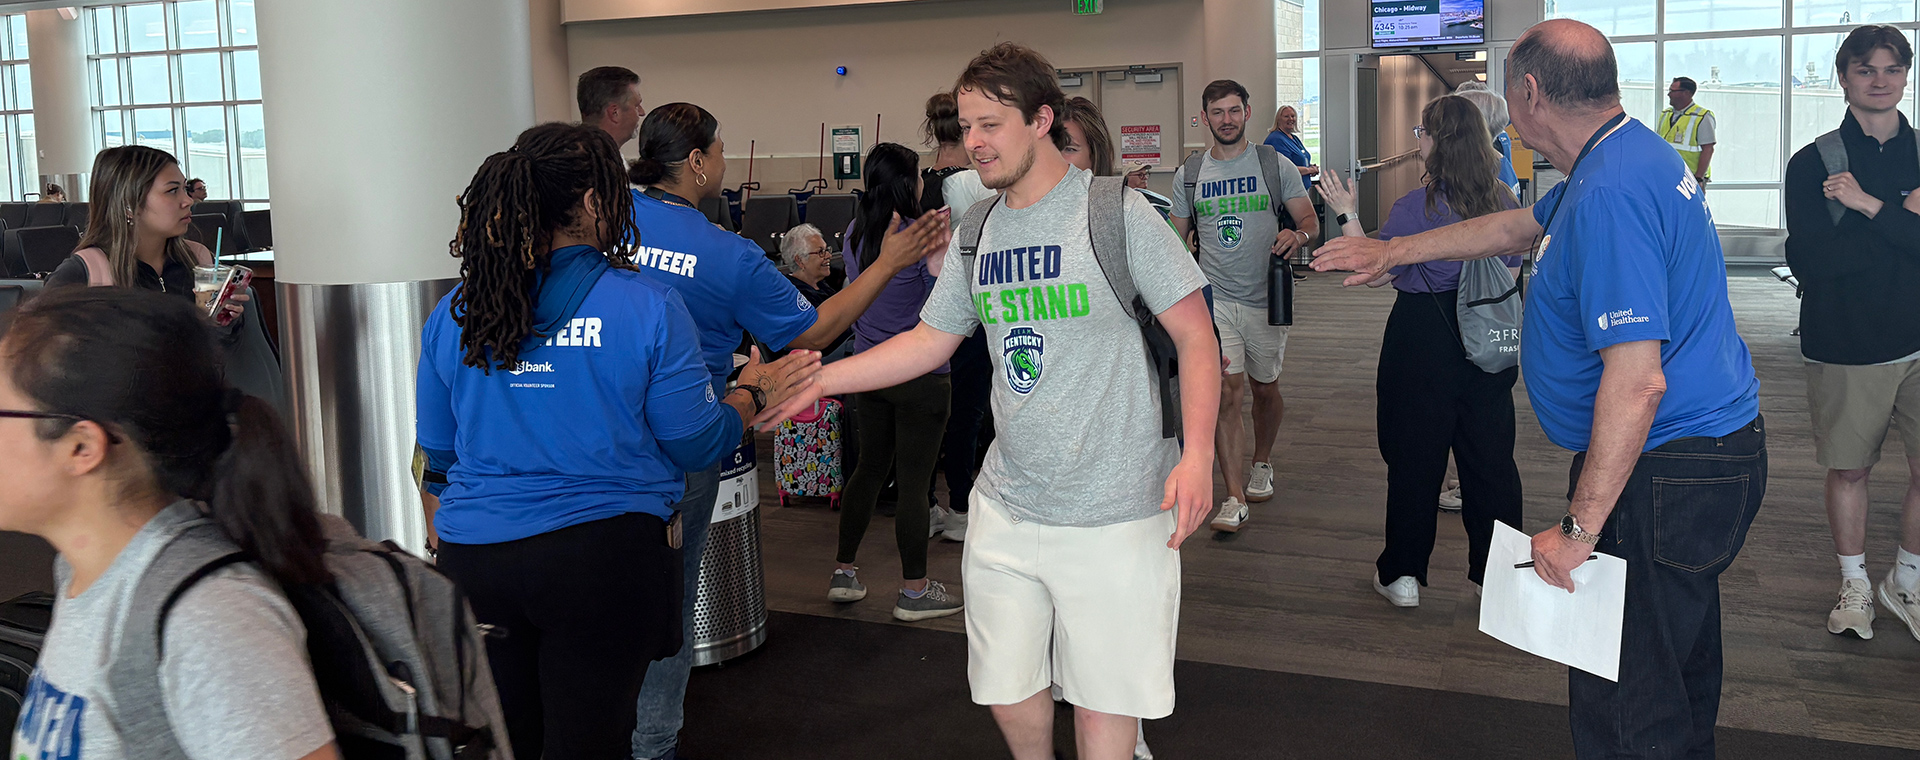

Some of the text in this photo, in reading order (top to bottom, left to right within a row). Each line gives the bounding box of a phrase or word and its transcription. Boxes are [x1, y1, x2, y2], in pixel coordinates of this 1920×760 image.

[1374, 6, 1398, 14] Chicago
[1374, 23, 1395, 31] 4345
[1201, 176, 1257, 198] UNITED
[1218, 194, 1269, 214] STAND
[978, 244, 1062, 286] UNITED
[1000, 283, 1090, 323] STAND
[1609, 307, 1633, 319] United
[1611, 316, 1650, 327] Healthcare
[1005, 335, 1042, 350] KENTUCKY
[720, 462, 753, 477] mixed recycling
